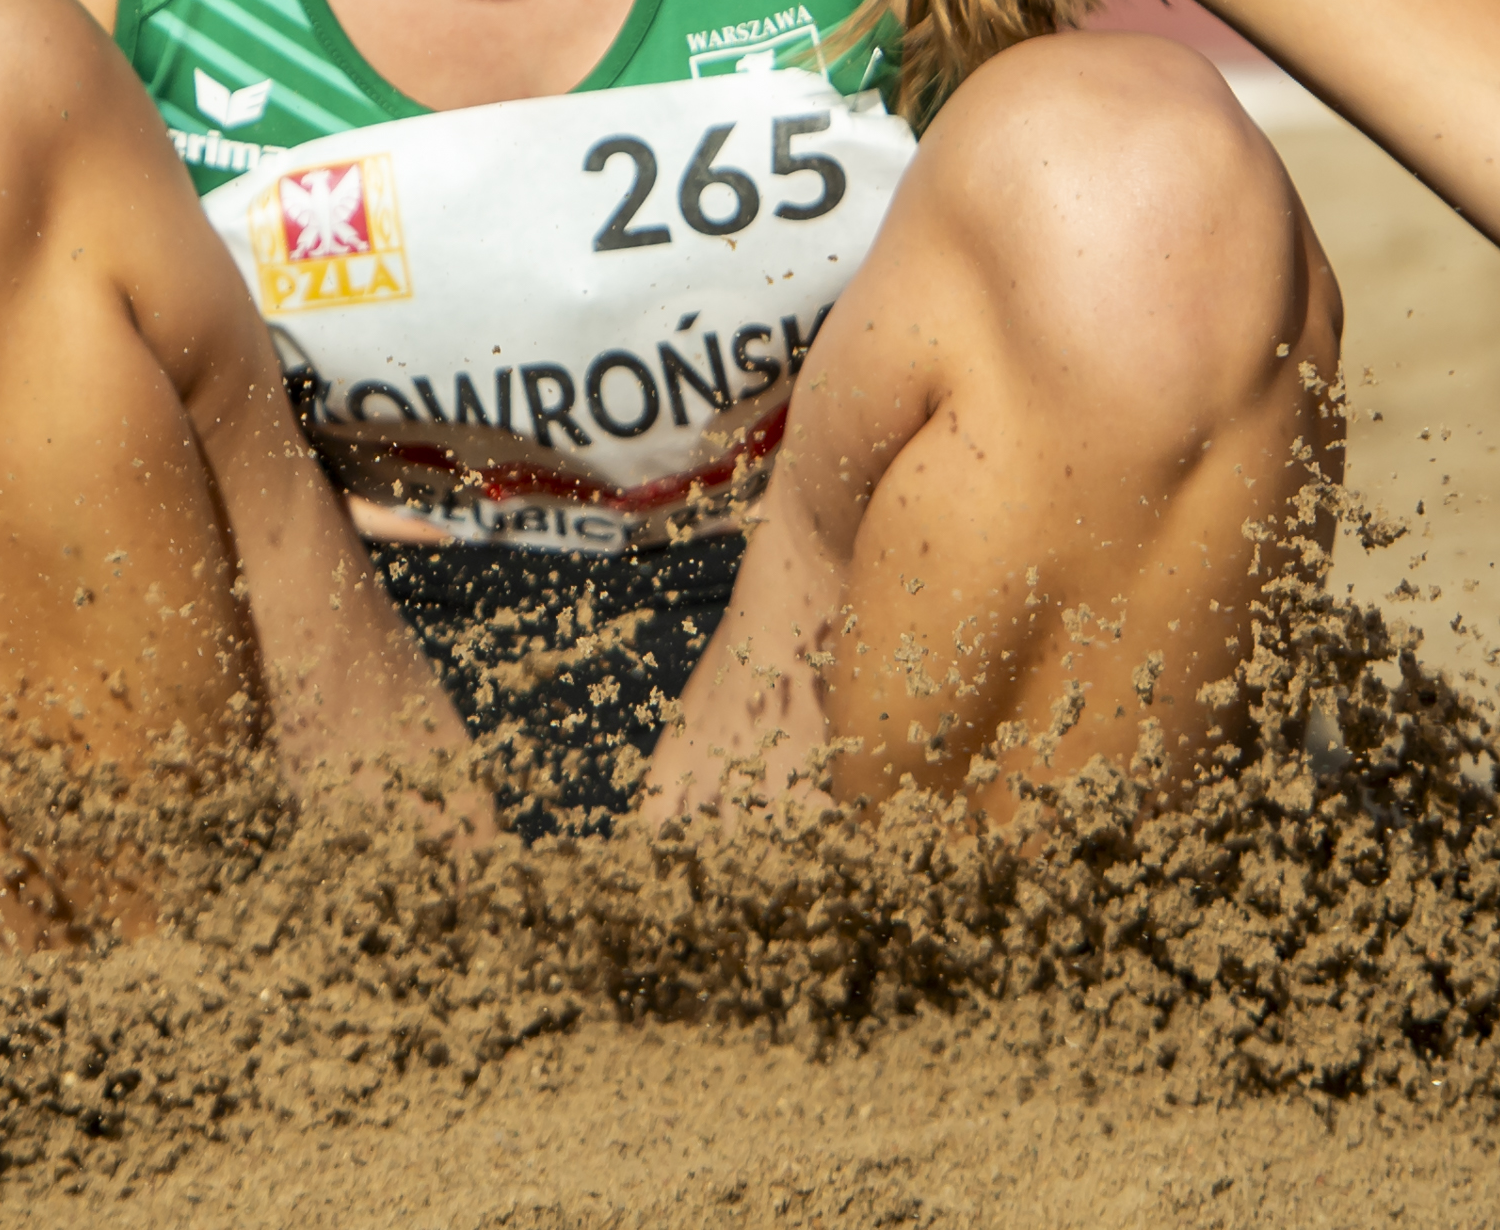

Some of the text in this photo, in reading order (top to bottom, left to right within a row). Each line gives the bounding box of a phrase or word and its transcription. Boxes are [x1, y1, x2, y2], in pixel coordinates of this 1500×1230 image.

[686, 4, 813, 54] WARSZAWA
[582, 109, 848, 253] 265
[263, 254, 402, 308] PZLA
